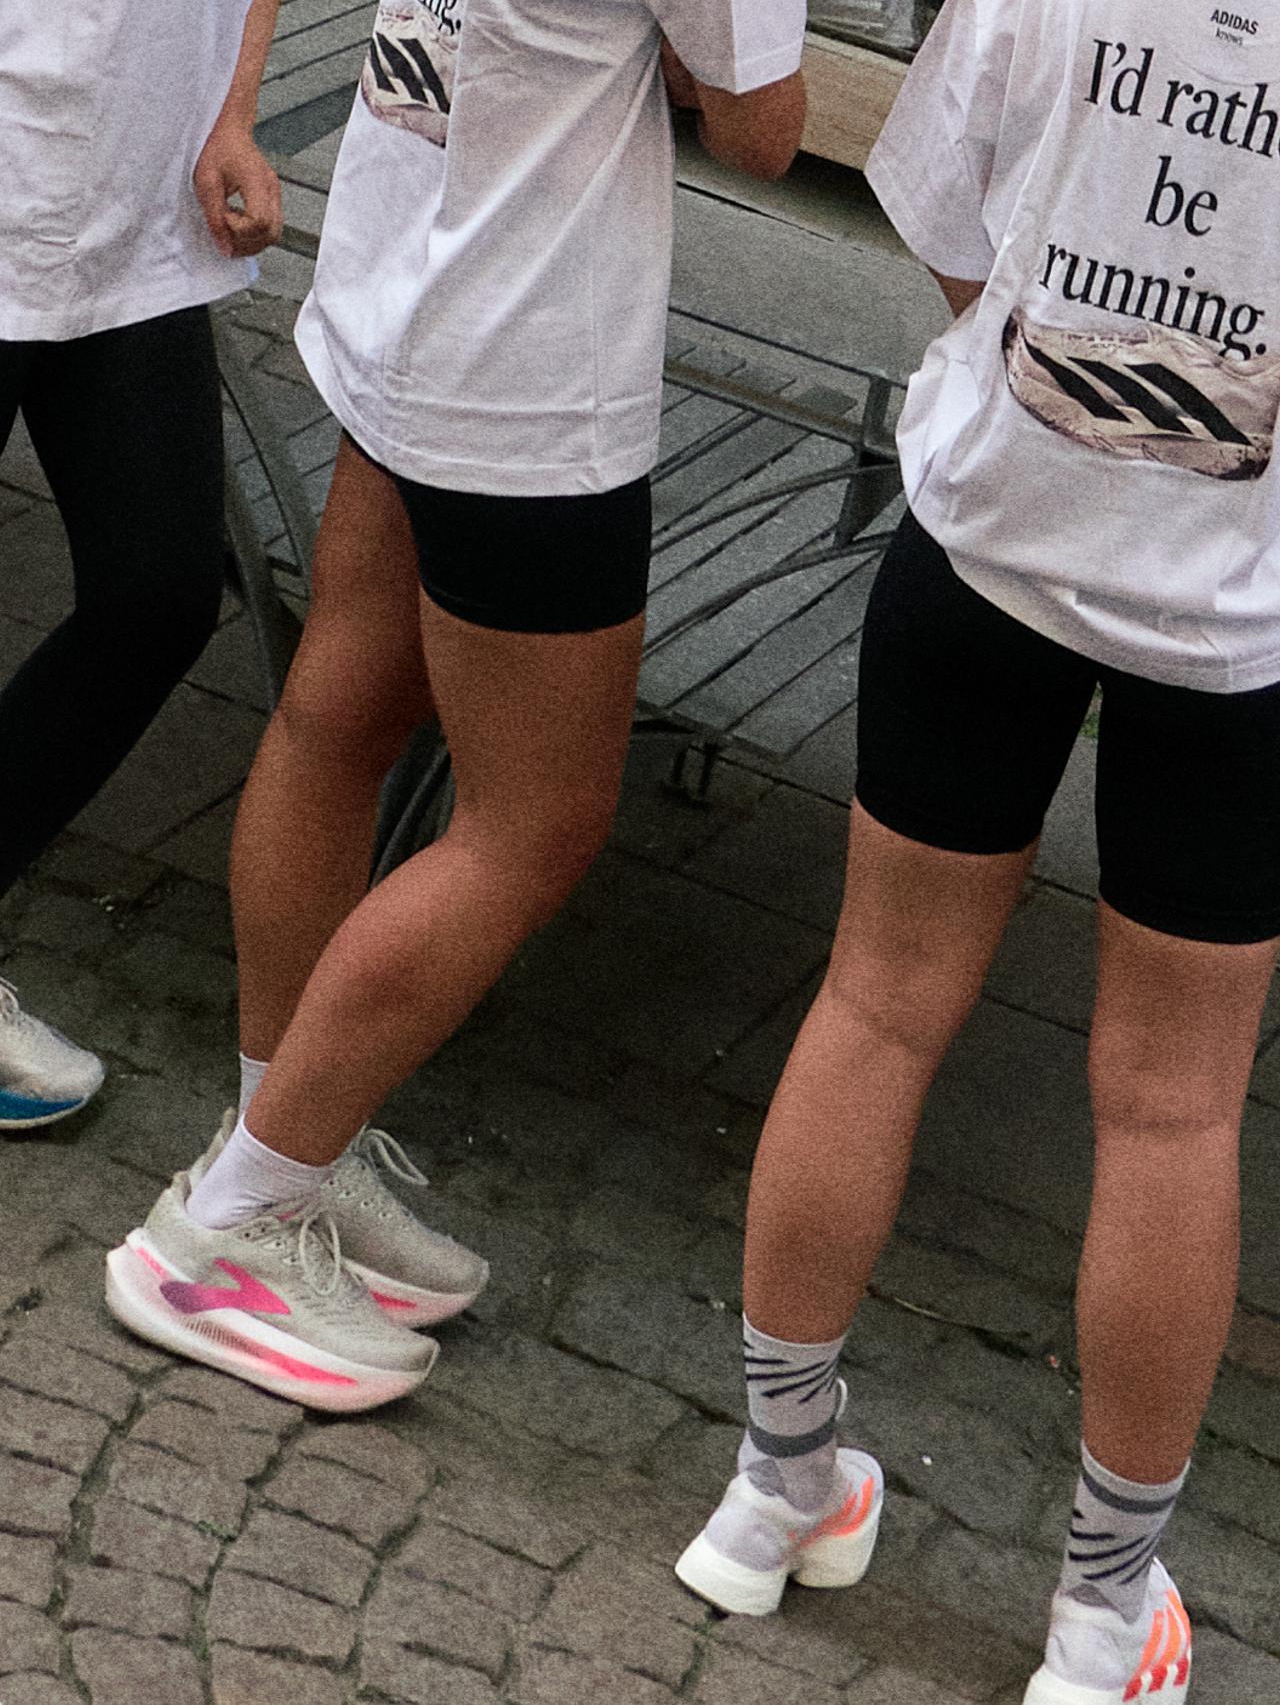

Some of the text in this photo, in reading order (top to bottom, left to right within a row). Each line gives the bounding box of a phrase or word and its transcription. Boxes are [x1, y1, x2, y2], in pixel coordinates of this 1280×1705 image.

[1210, 8, 1260, 35] ADIDAS
[1084, 38, 1156, 117] I'd
[1144, 155, 1219, 238] be
[1038, 242, 1268, 362] running.
